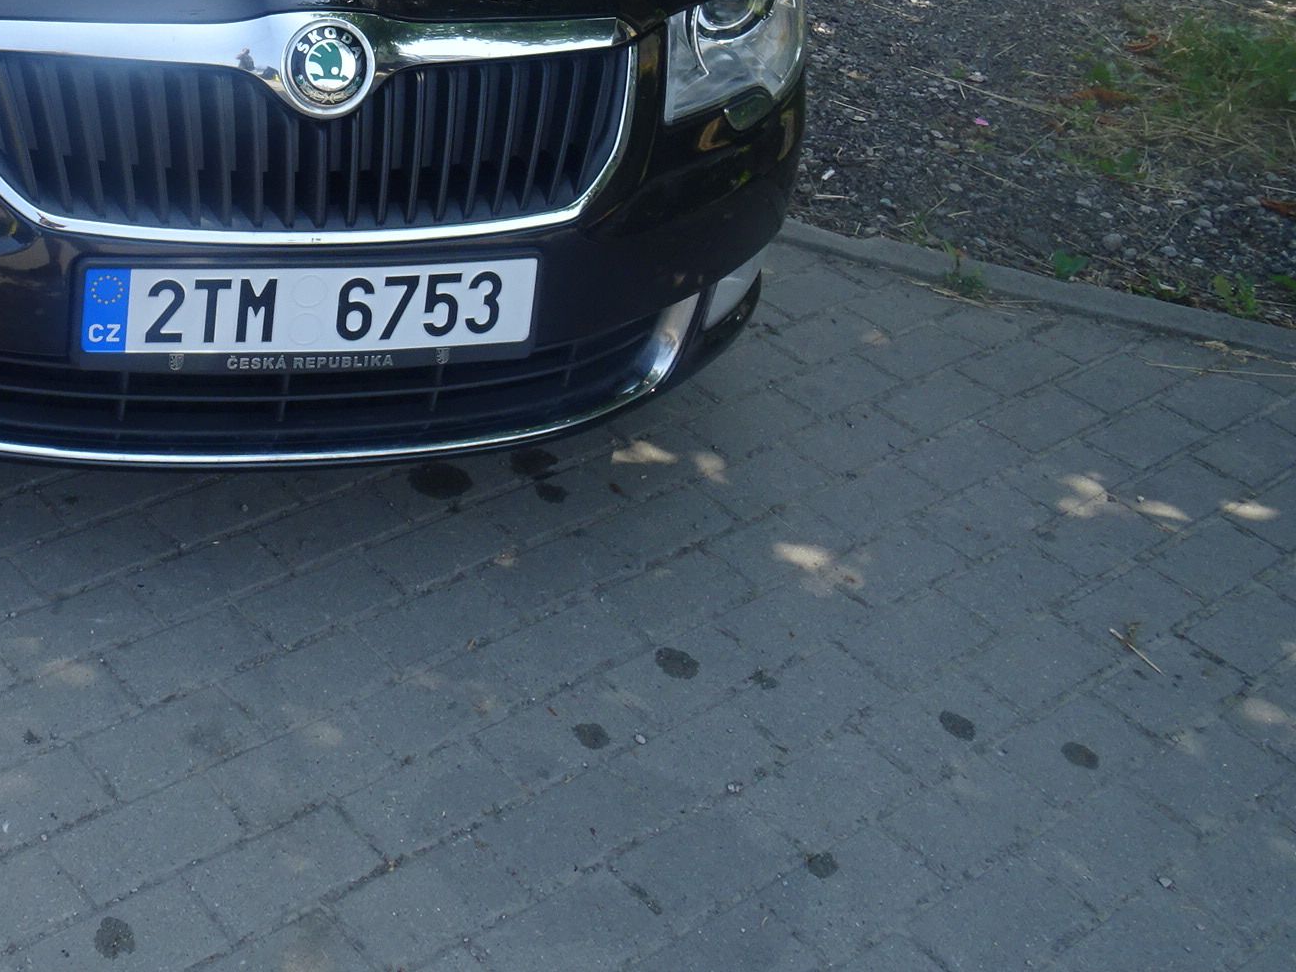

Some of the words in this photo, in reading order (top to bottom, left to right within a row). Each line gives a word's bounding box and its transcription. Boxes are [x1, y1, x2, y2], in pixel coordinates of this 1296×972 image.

[144, 278, 279, 343] 2TM
[335, 271, 503, 341] 6753
[87, 323, 121, 343] CZ
[226, 354, 287, 370] ČESKÁ
[292, 353, 394, 369] REPUBLIKA
